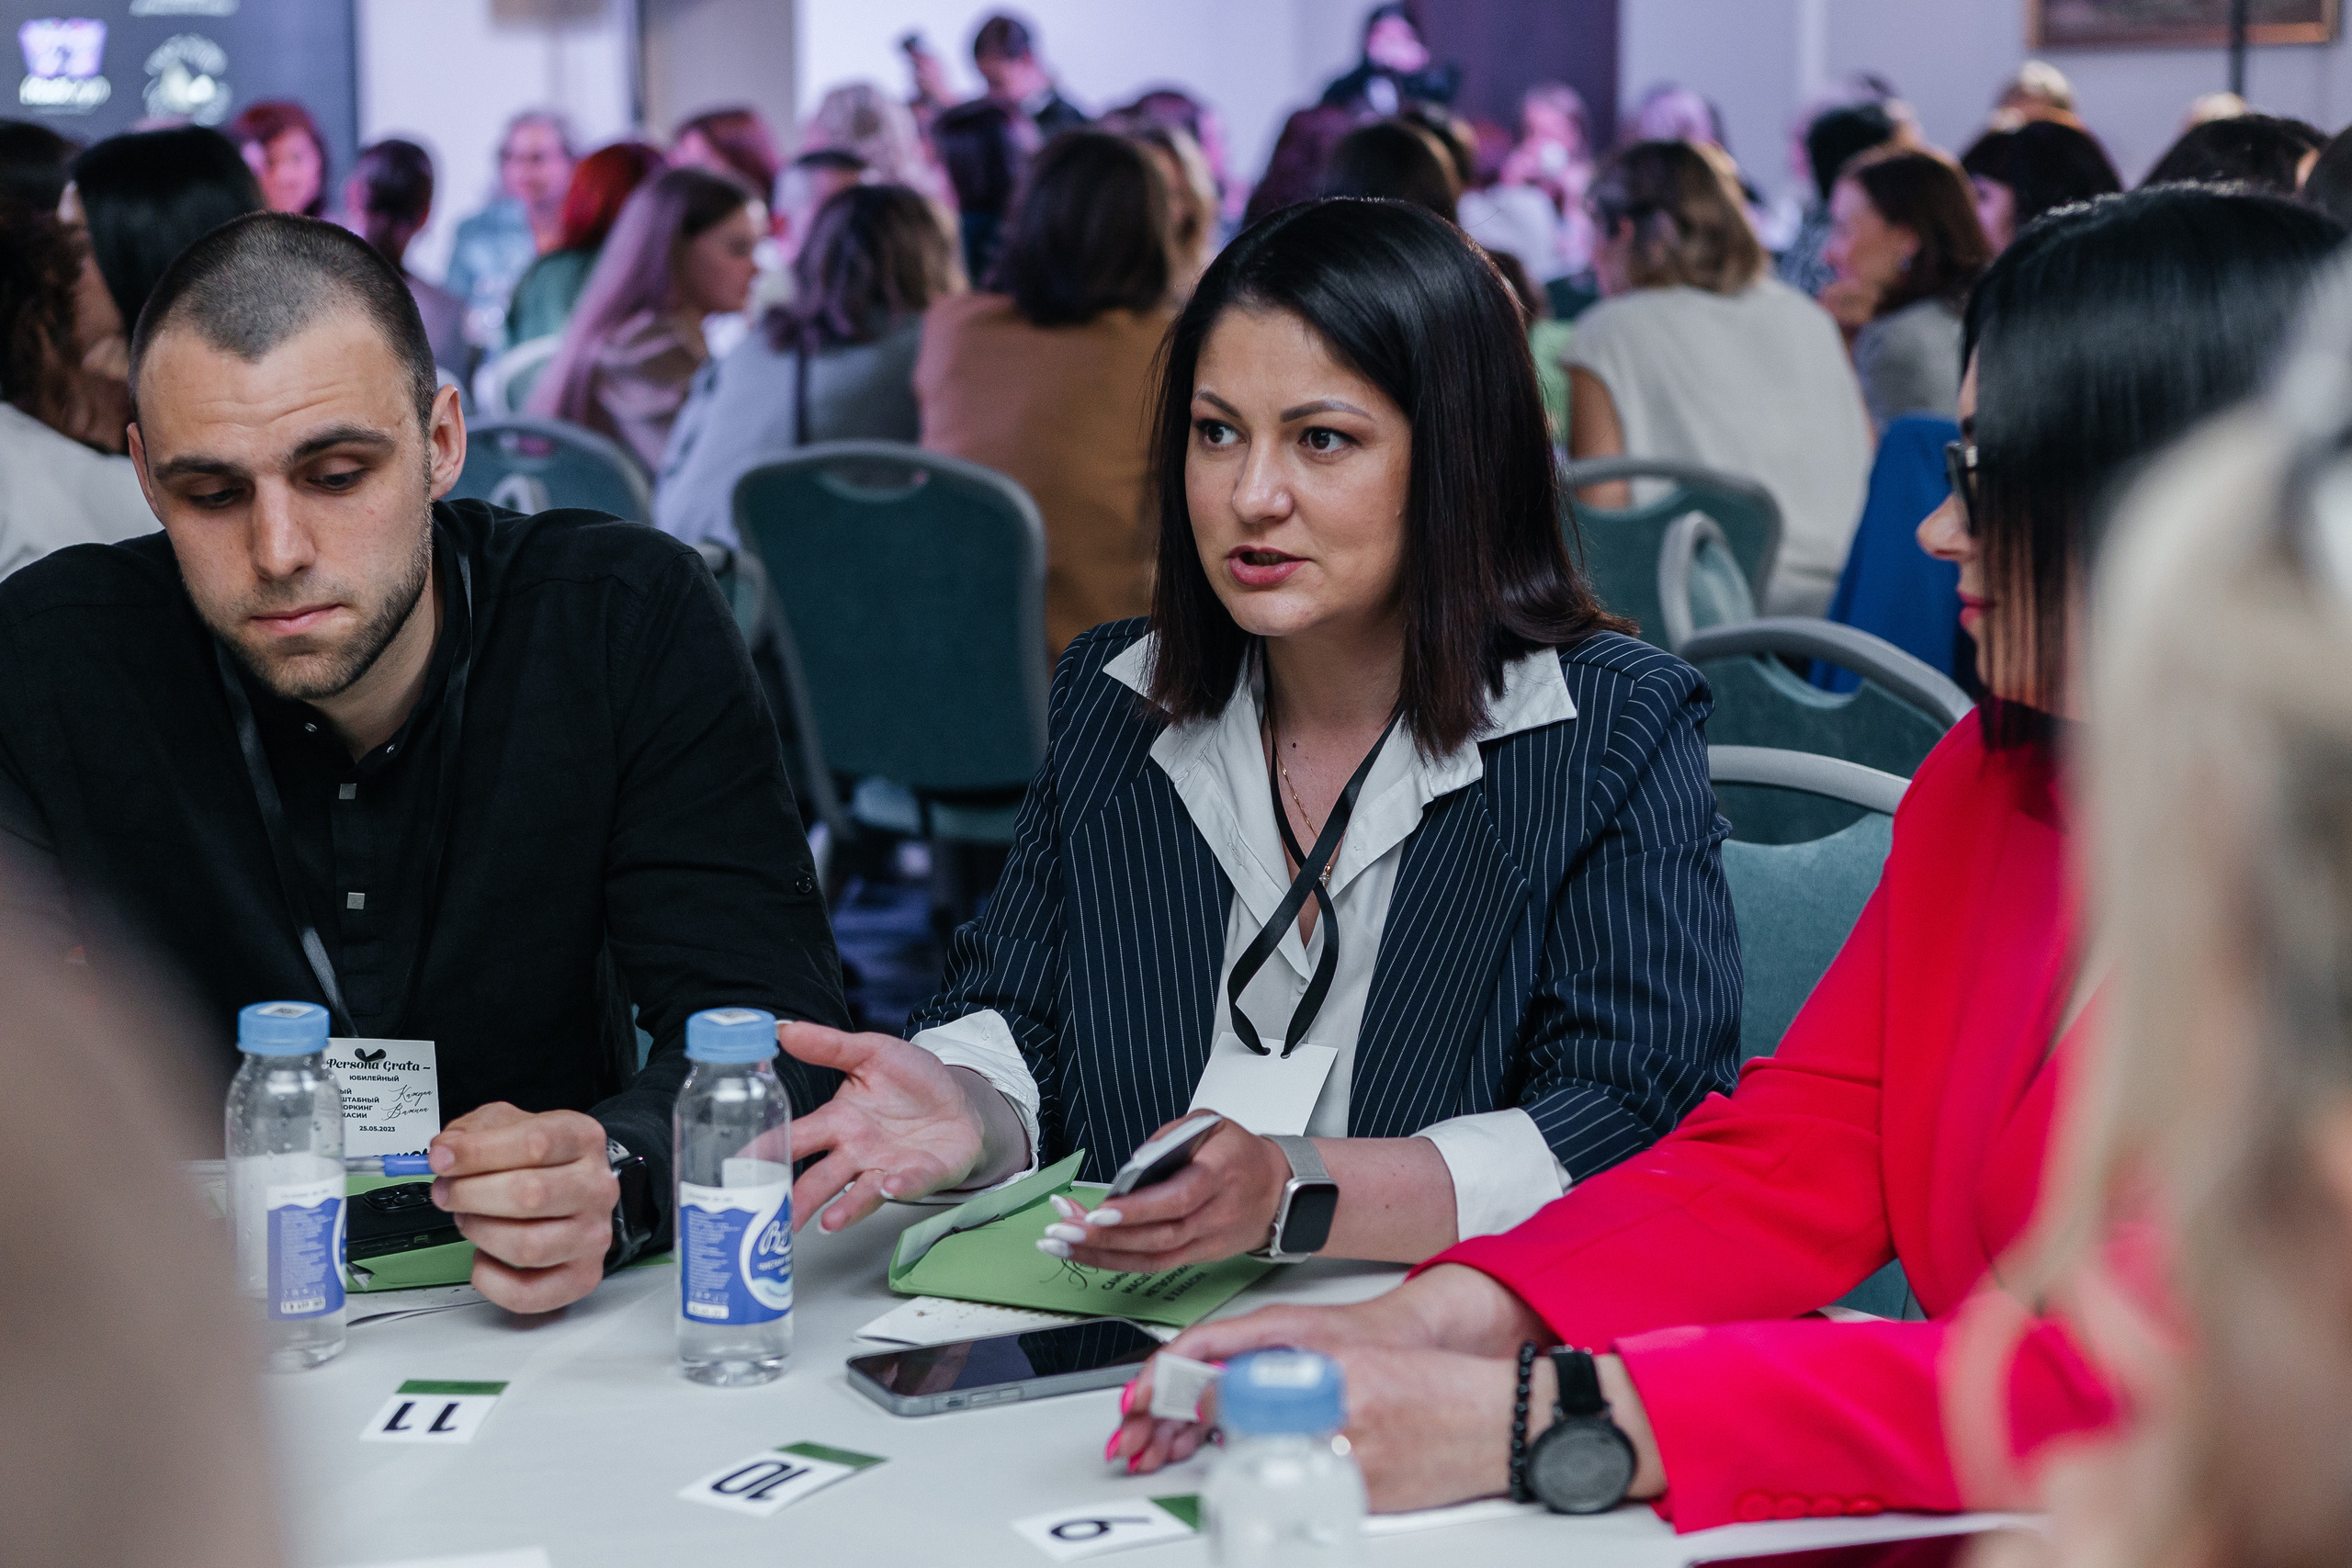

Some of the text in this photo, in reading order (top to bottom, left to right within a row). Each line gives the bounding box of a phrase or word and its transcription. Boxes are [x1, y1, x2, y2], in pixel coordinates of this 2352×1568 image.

[326, 1058, 379, 1071] Persona
[383, 1060, 420, 1072] Grata
[349, 1074, 400, 1082] ЮБИЛЕЙНЫЙ
[382, 1402, 460, 1432] 11
[710, 1461, 813, 1501] 10
